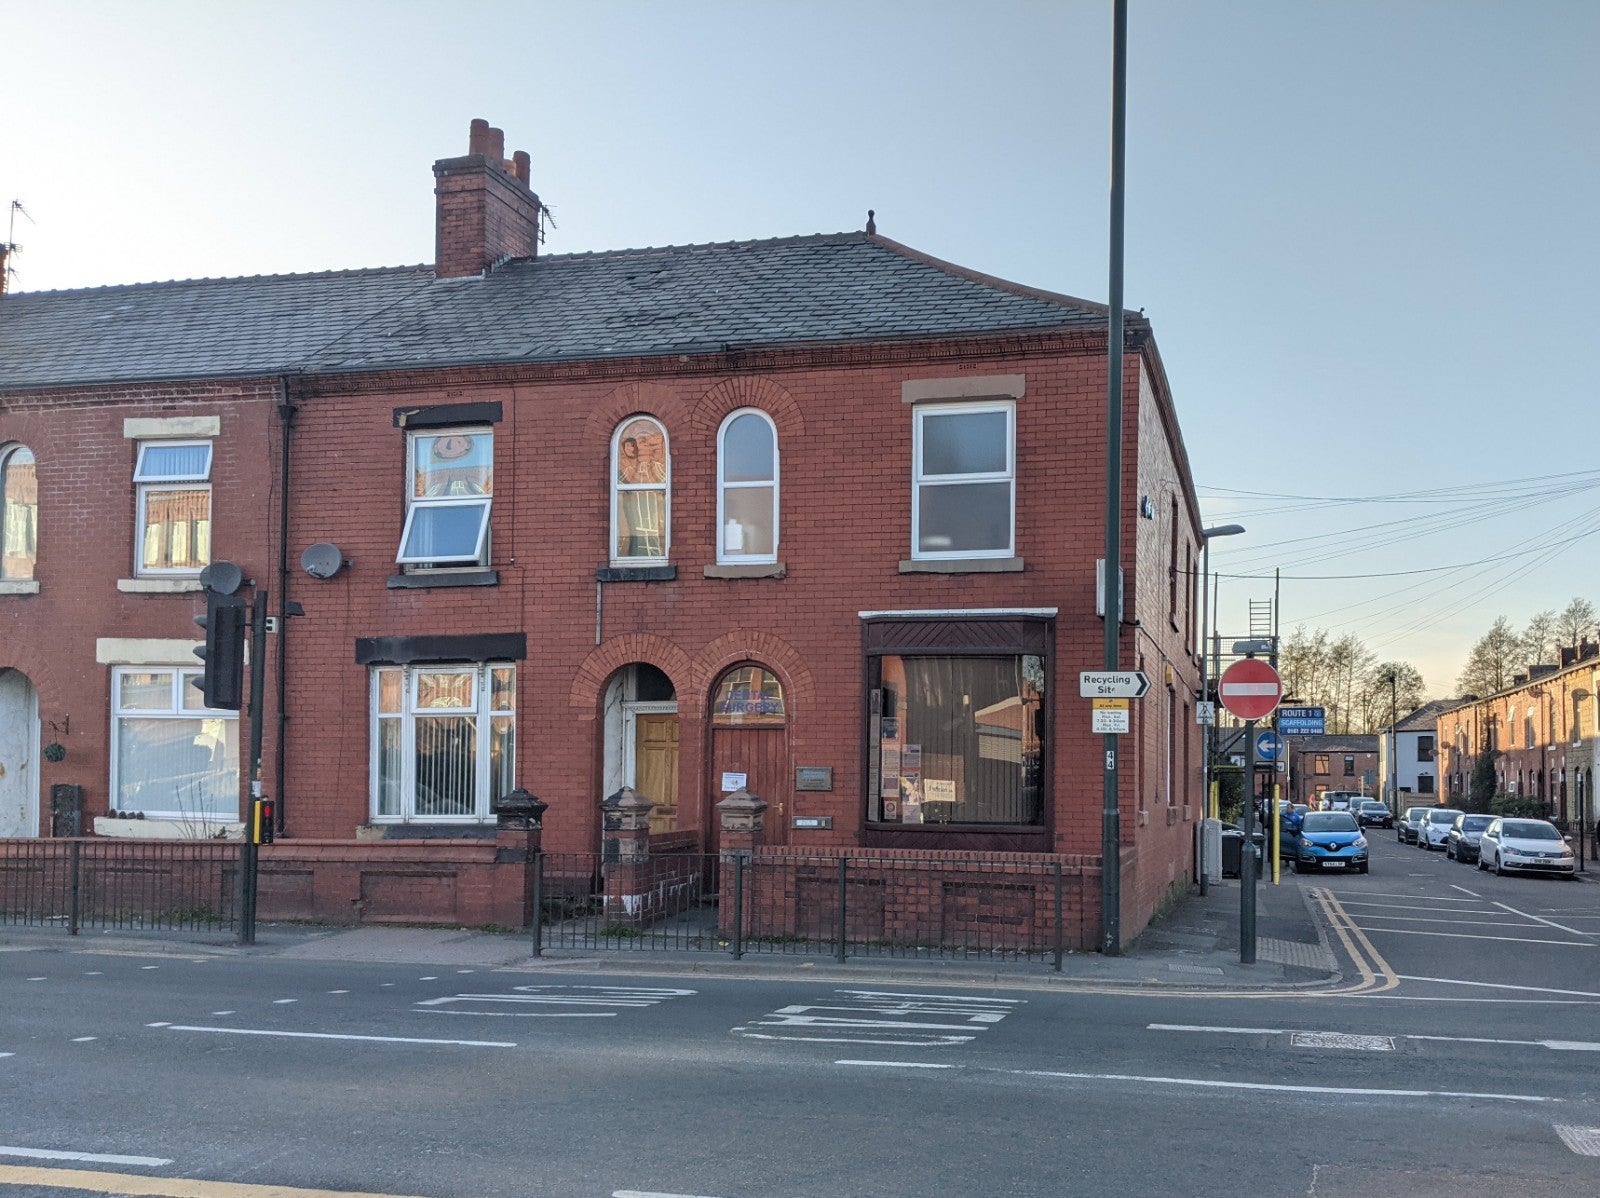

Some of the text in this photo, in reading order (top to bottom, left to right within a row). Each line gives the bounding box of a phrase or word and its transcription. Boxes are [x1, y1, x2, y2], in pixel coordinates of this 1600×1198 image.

[1084, 675, 1131, 685] Recycling
[719, 702, 779, 713] SURGERY
[1281, 709, 1307, 717] ROUTE
[1308, 709, 1312, 717] 1
